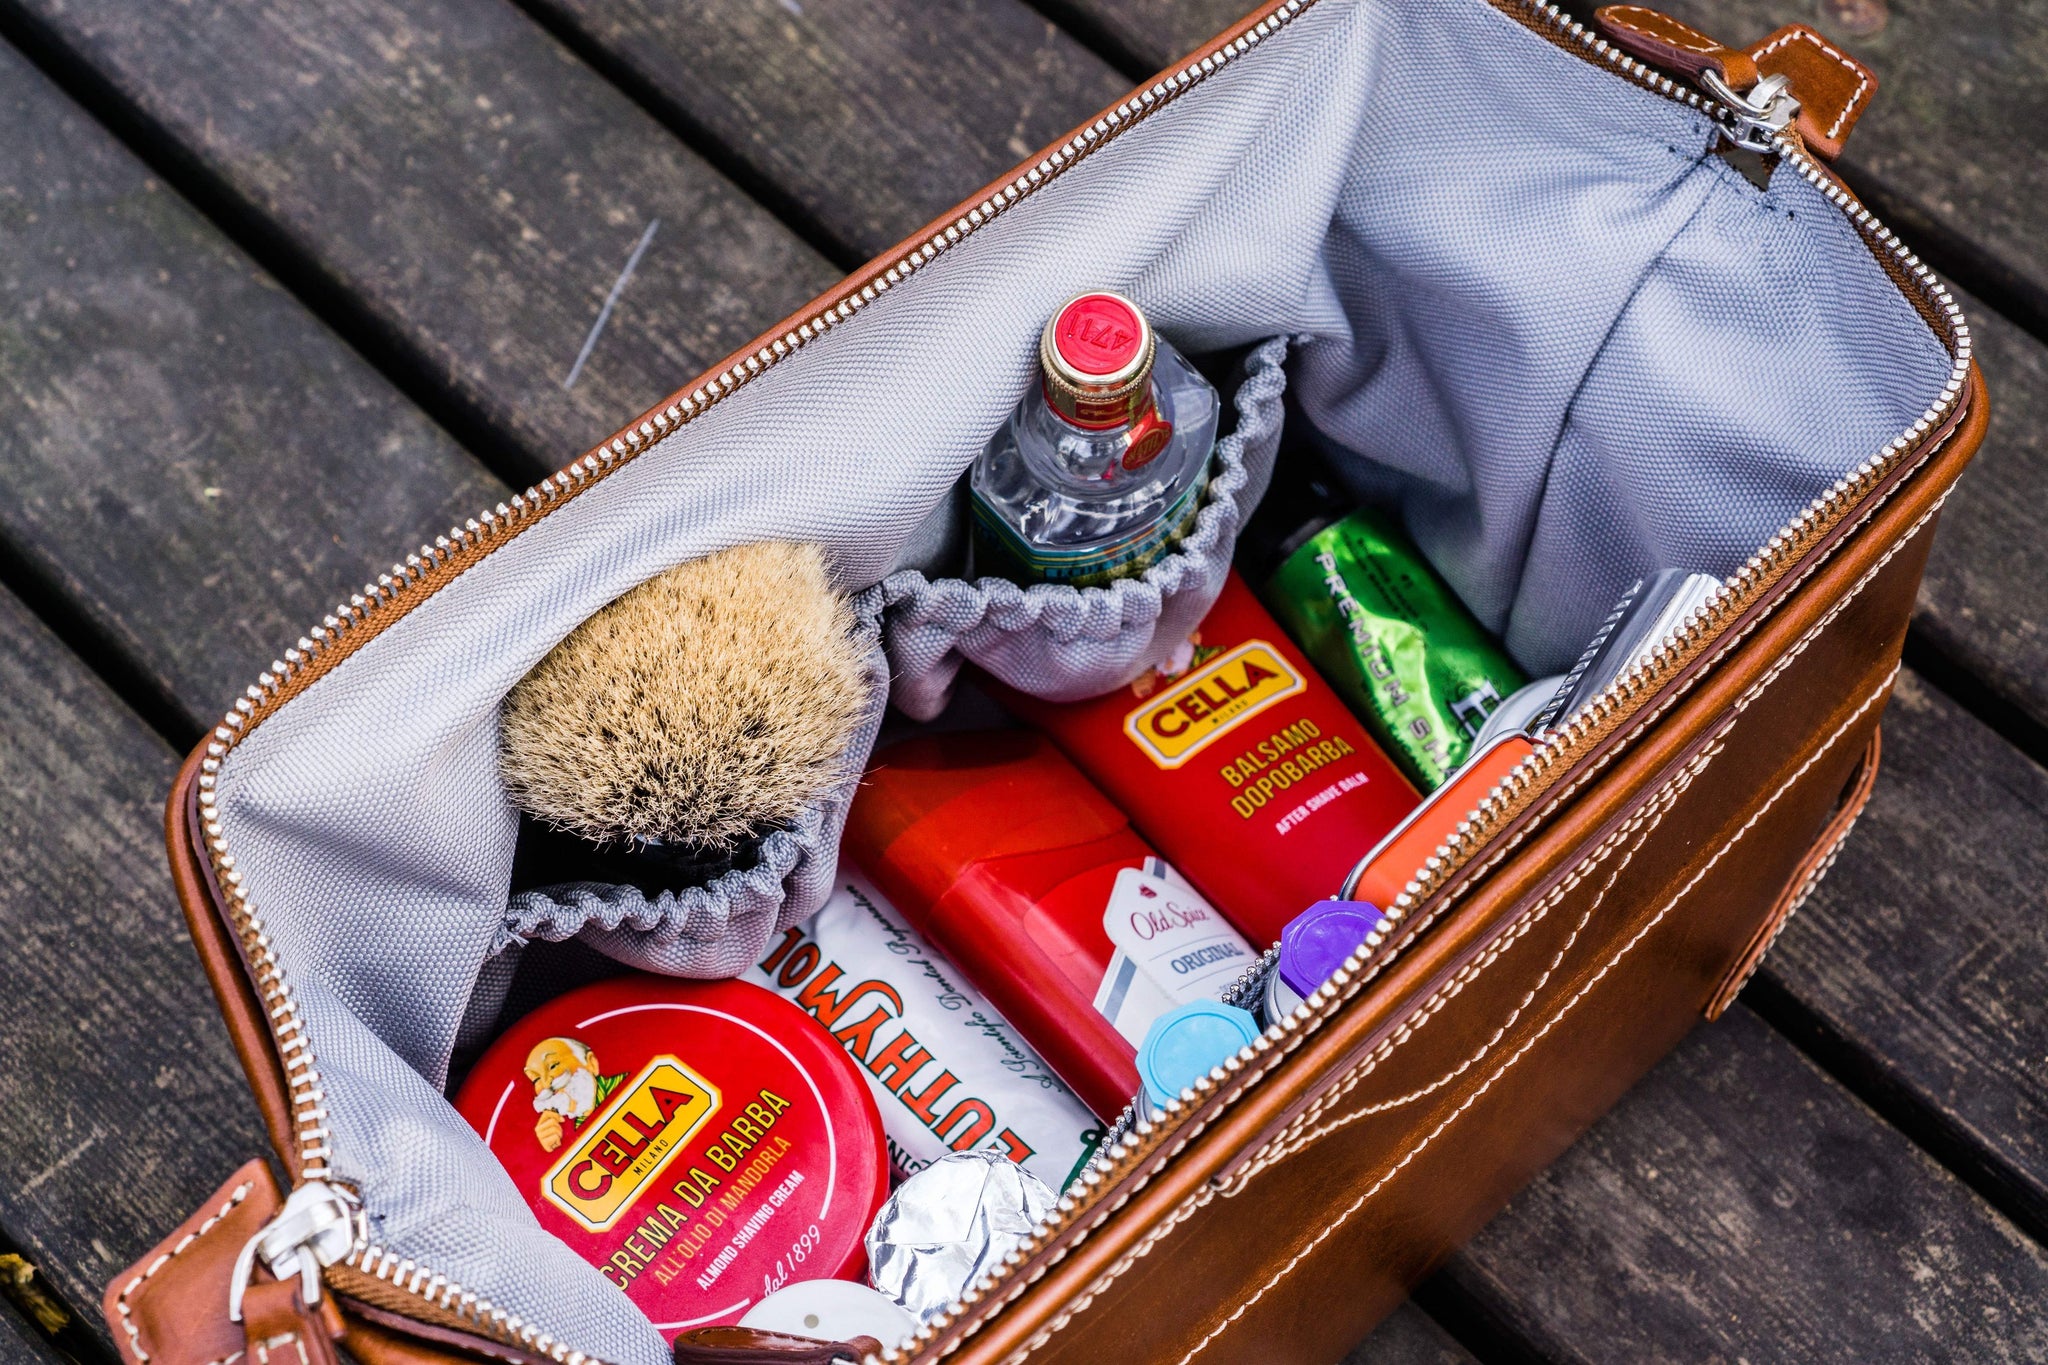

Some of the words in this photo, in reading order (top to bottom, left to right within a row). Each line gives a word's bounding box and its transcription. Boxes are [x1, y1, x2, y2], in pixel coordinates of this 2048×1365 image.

[1068, 311, 1134, 351] 4711
[1314, 552, 1410, 707] PREMIUM
[1151, 661, 1280, 738] CELLA
[1220, 718, 1321, 787] BALSAMO
[1231, 735, 1355, 819] DOPOBARBA
[1275, 805, 1311, 835] AFTER
[1305, 785, 1342, 812] SHAVE
[1338, 771, 1369, 792] BALM
[1130, 909, 1174, 940] Old
[1166, 901, 1211, 929] Spice
[907, 959, 972, 1011] Dental
[1171, 942, 1244, 974] ORIGINAL
[965, 1011, 1040, 1073] Scientific
[567, 1086, 694, 1202] CELLA
[633, 1138, 669, 1177] MILANO
[599, 1202, 689, 1292] CREMA
[672, 1165, 722, 1209] DA
[705, 1088, 792, 1173] BARBA
[654, 1223, 713, 1287] ALL'OLIO
[704, 1206, 728, 1228] DI
[720, 1135, 792, 1211] MANDORLA
[695, 1245, 738, 1291] ALMOND
[731, 1203, 775, 1250] SHAVING
[768, 1169, 806, 1208] CREAM
[764, 1273, 789, 1298] dal
[785, 1223, 821, 1272] 1899
